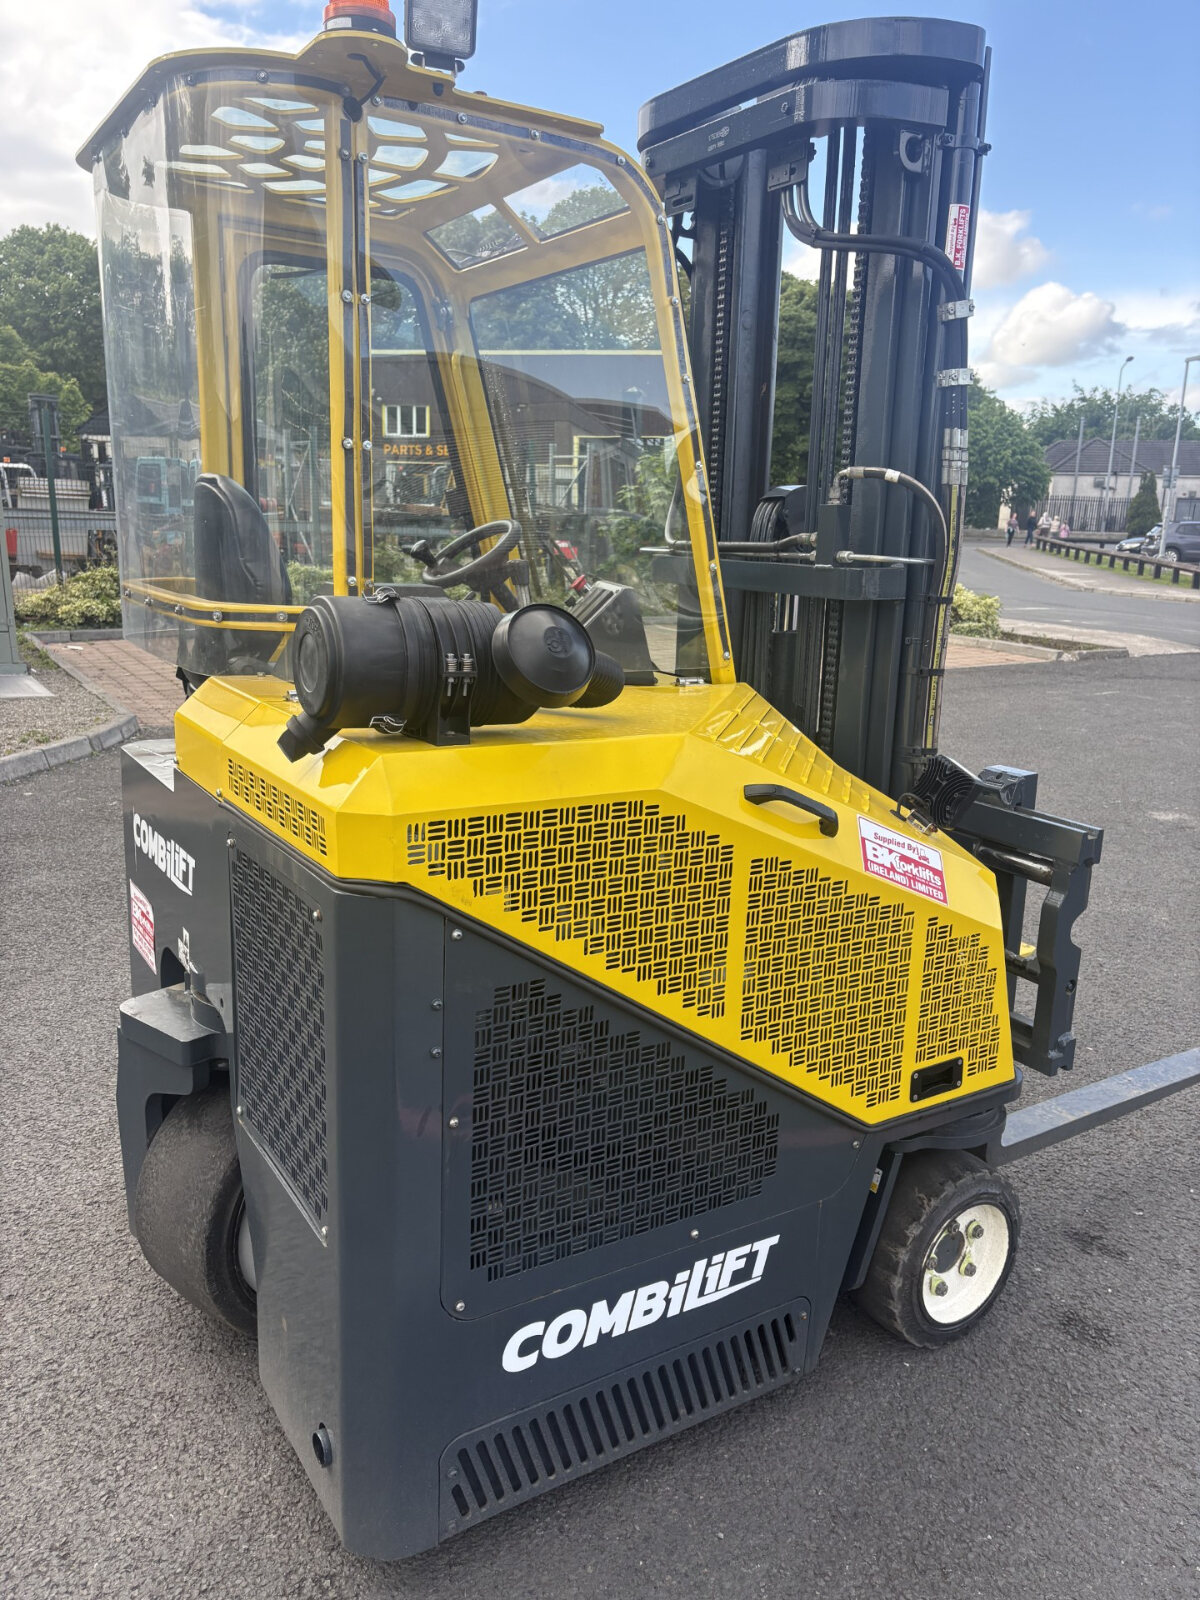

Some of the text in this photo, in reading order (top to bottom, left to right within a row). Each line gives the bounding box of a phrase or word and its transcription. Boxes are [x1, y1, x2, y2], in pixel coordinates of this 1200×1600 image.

[957, 208, 966, 249] FORKLIFTS
[383, 443, 422, 456] PARTS
[425, 444, 433, 456] &
[874, 832, 905, 848] Supplied
[868, 860, 944, 900] (IRELAND) LIMITED
